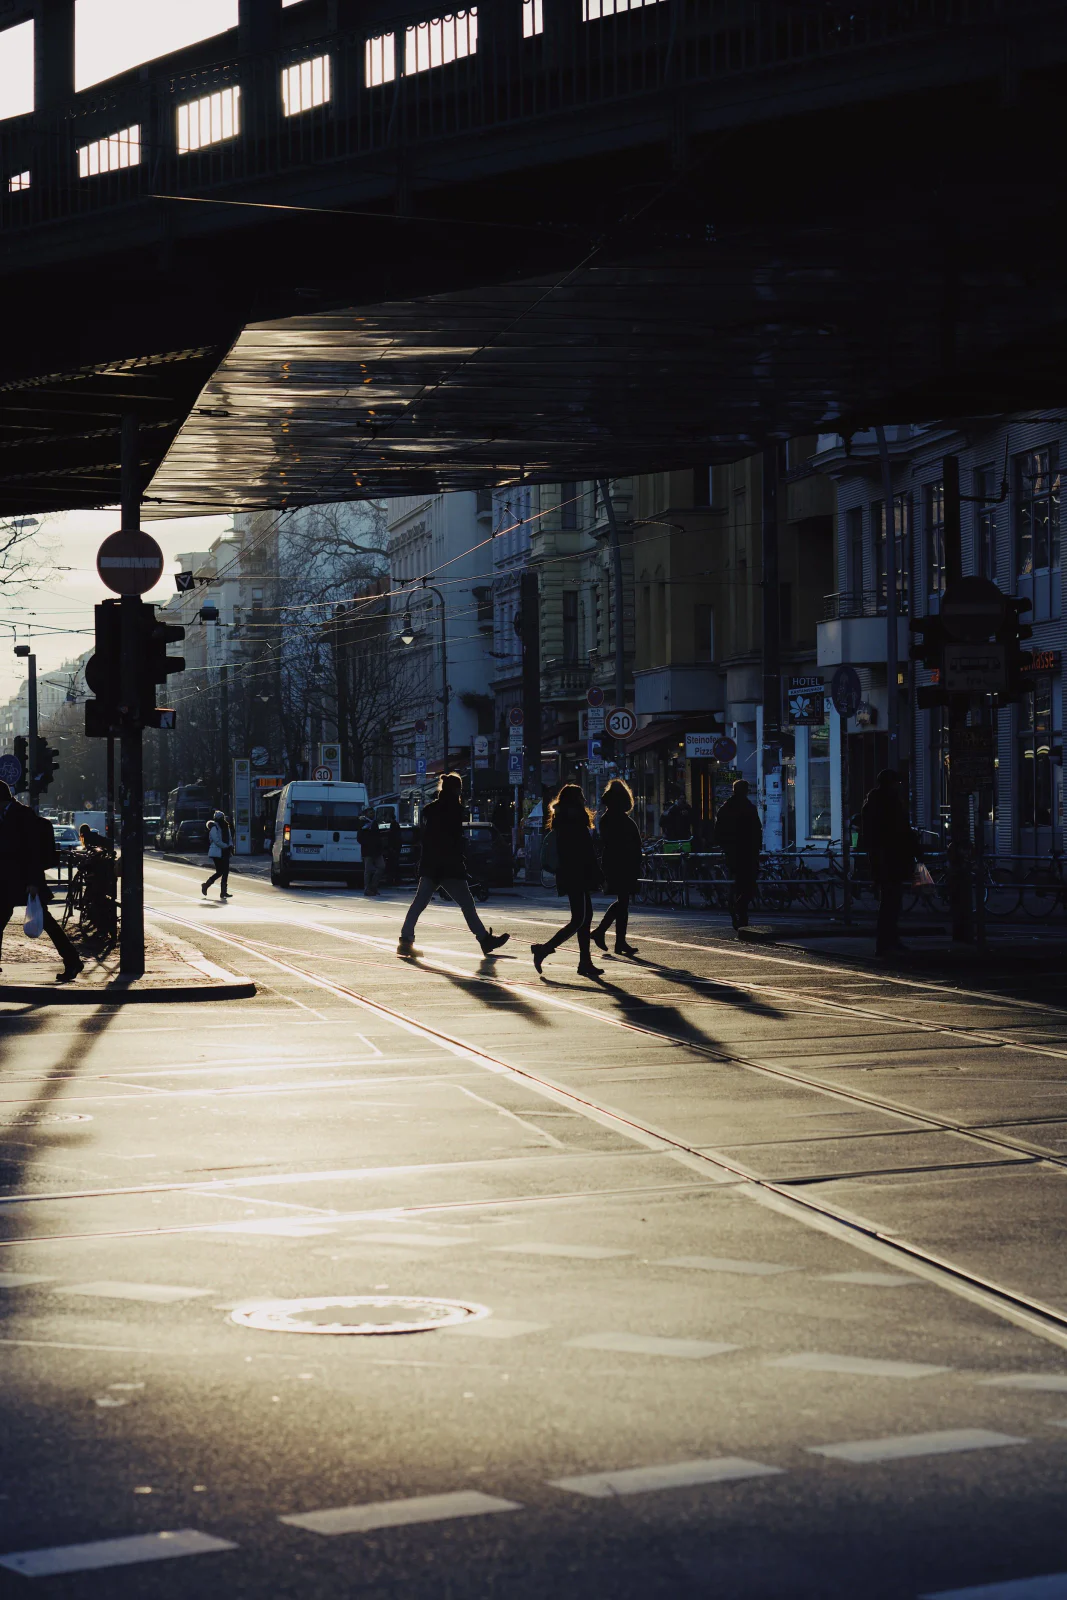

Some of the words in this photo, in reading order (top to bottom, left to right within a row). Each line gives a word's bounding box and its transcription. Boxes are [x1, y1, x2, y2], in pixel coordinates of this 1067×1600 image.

[792, 677, 820, 686] HOTEL
[612, 716, 630, 730] 30
[418, 760, 424, 772] P
[510, 755, 519, 770] P
[316, 770, 329, 780] 30
